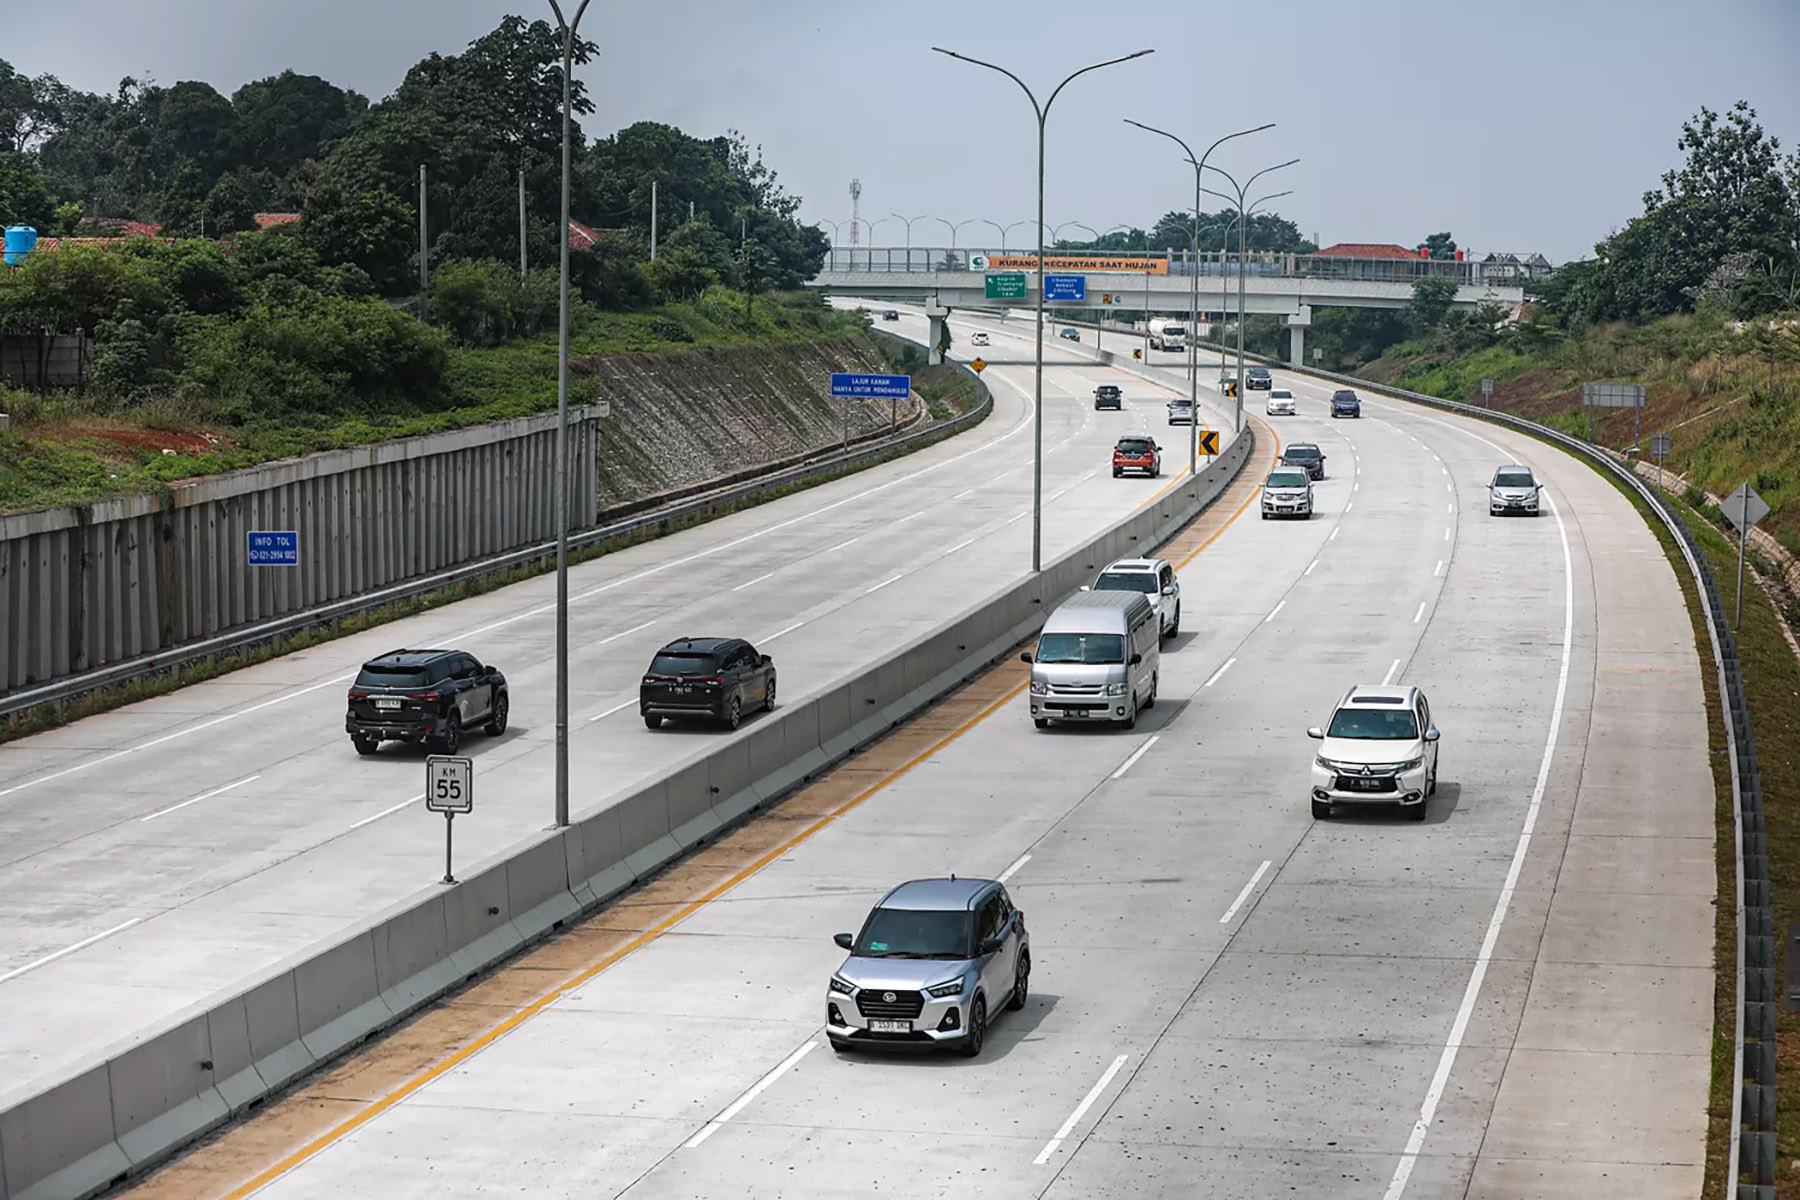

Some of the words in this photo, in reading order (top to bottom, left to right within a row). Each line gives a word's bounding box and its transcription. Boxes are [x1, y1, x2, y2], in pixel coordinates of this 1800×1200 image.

[1044, 260, 1097, 268] KECEPATAN
[255, 537, 272, 546] INFO
[276, 537, 290, 546] TOL
[442, 767, 456, 777] KM
[437, 779, 461, 799] 55
